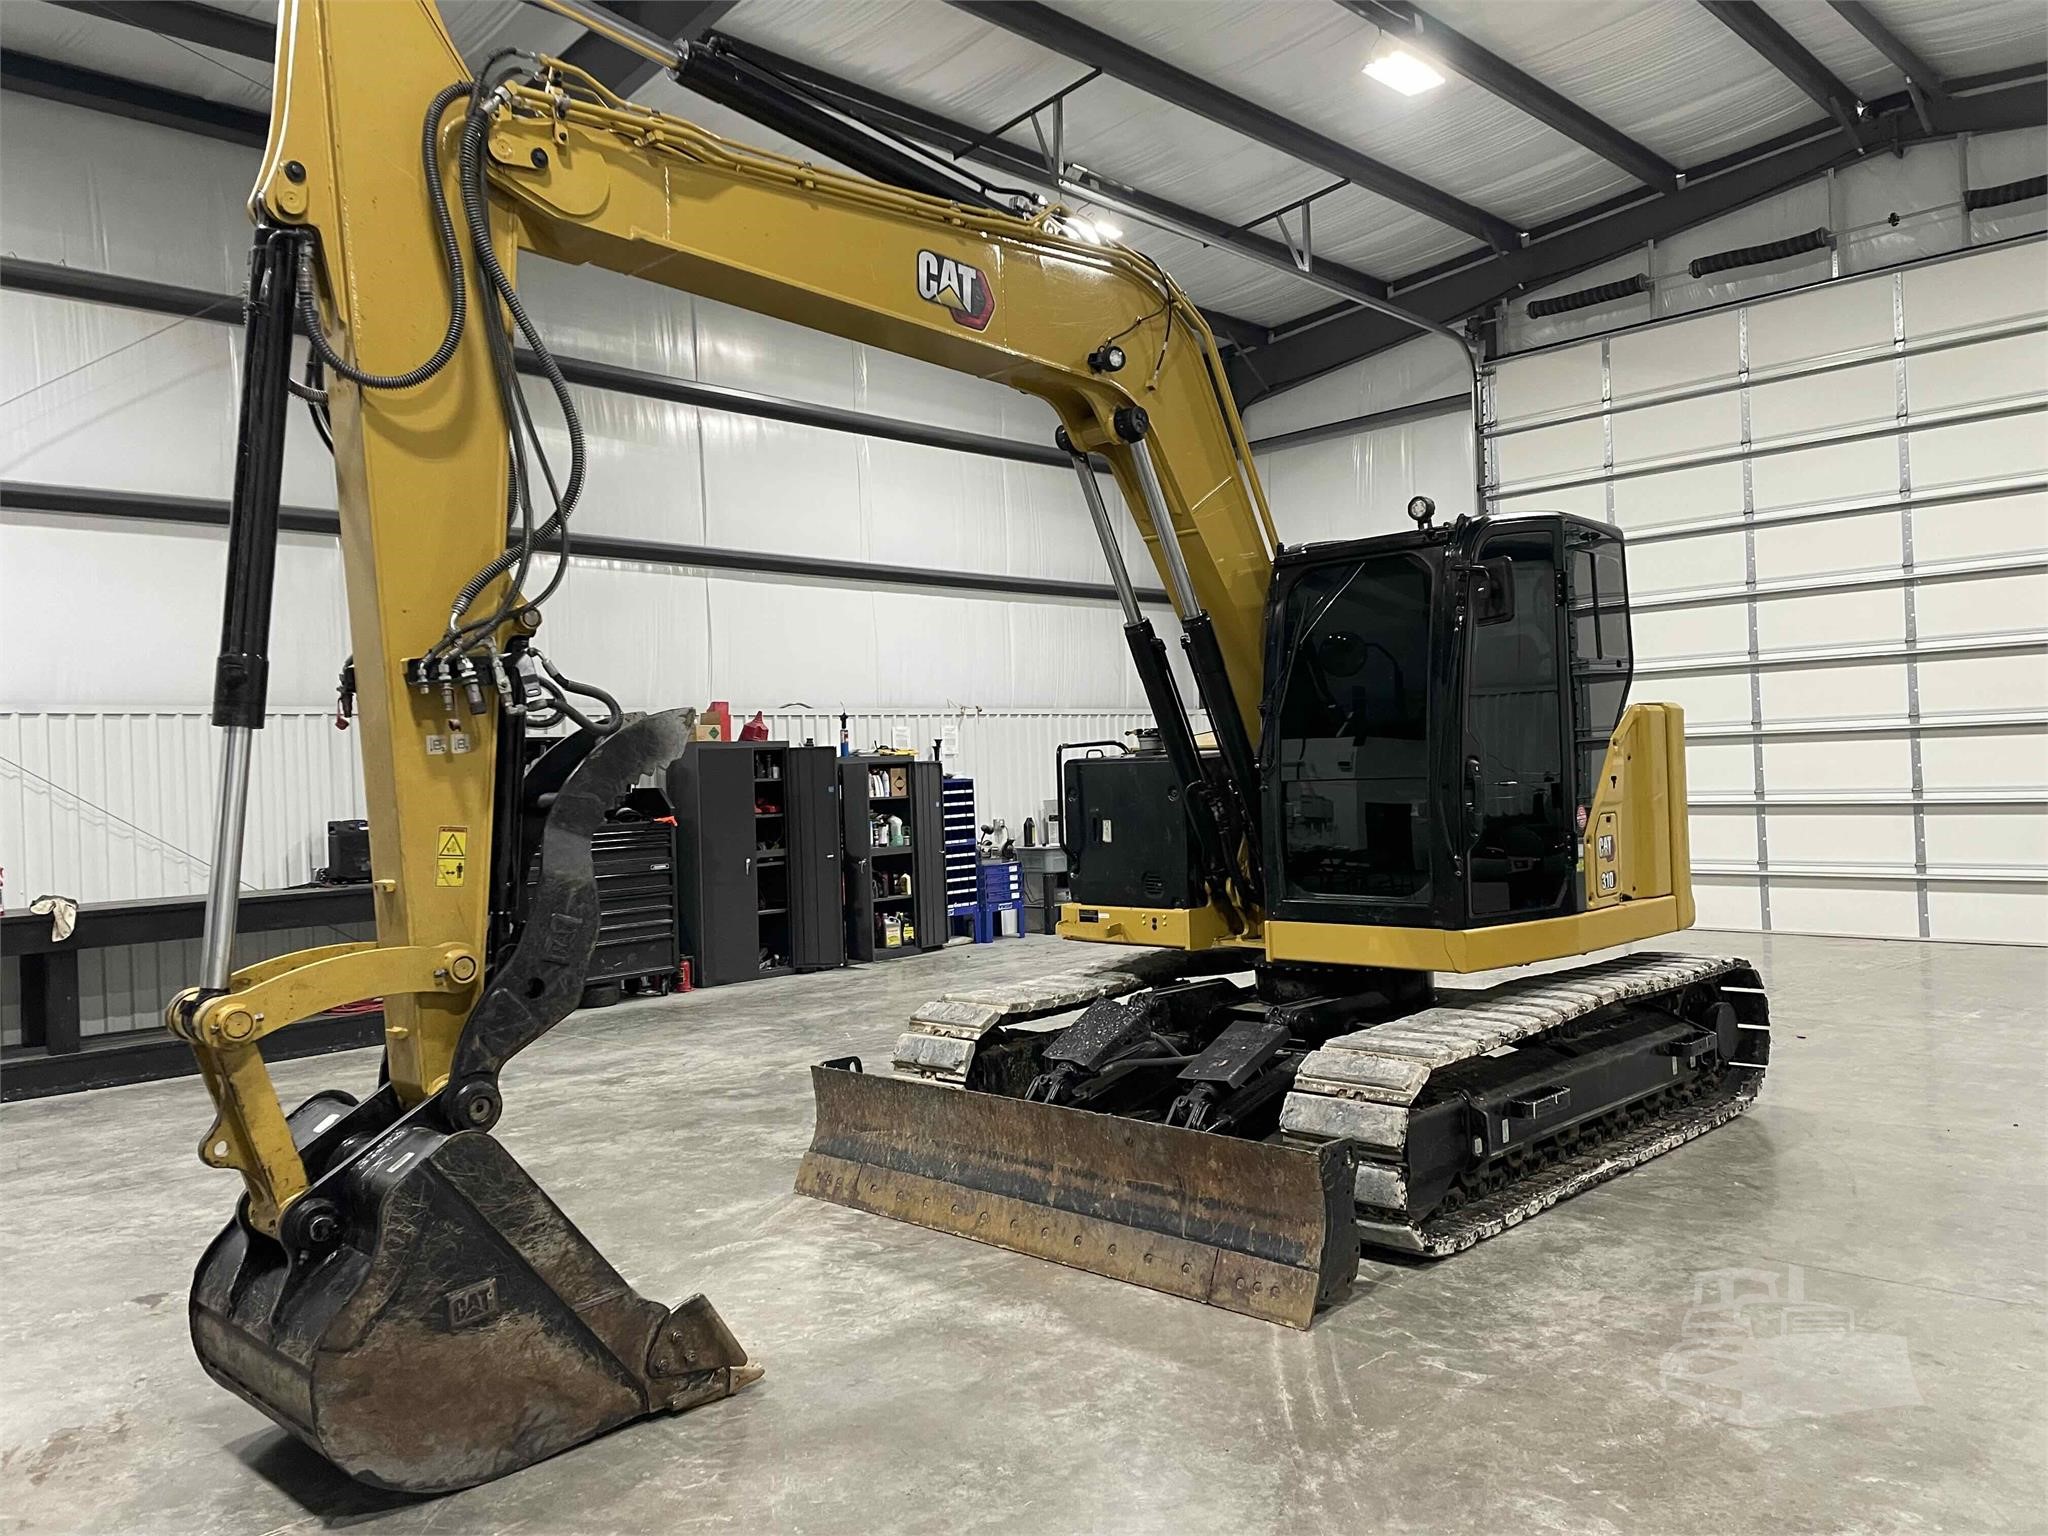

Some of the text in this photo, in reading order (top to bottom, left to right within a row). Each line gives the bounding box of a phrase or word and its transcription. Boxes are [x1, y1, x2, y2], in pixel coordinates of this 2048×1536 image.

[918, 250, 977, 313] CAT
[1599, 836, 1612, 858] CAT
[1602, 871, 1614, 889] 310
[453, 1287, 491, 1323] CAT
